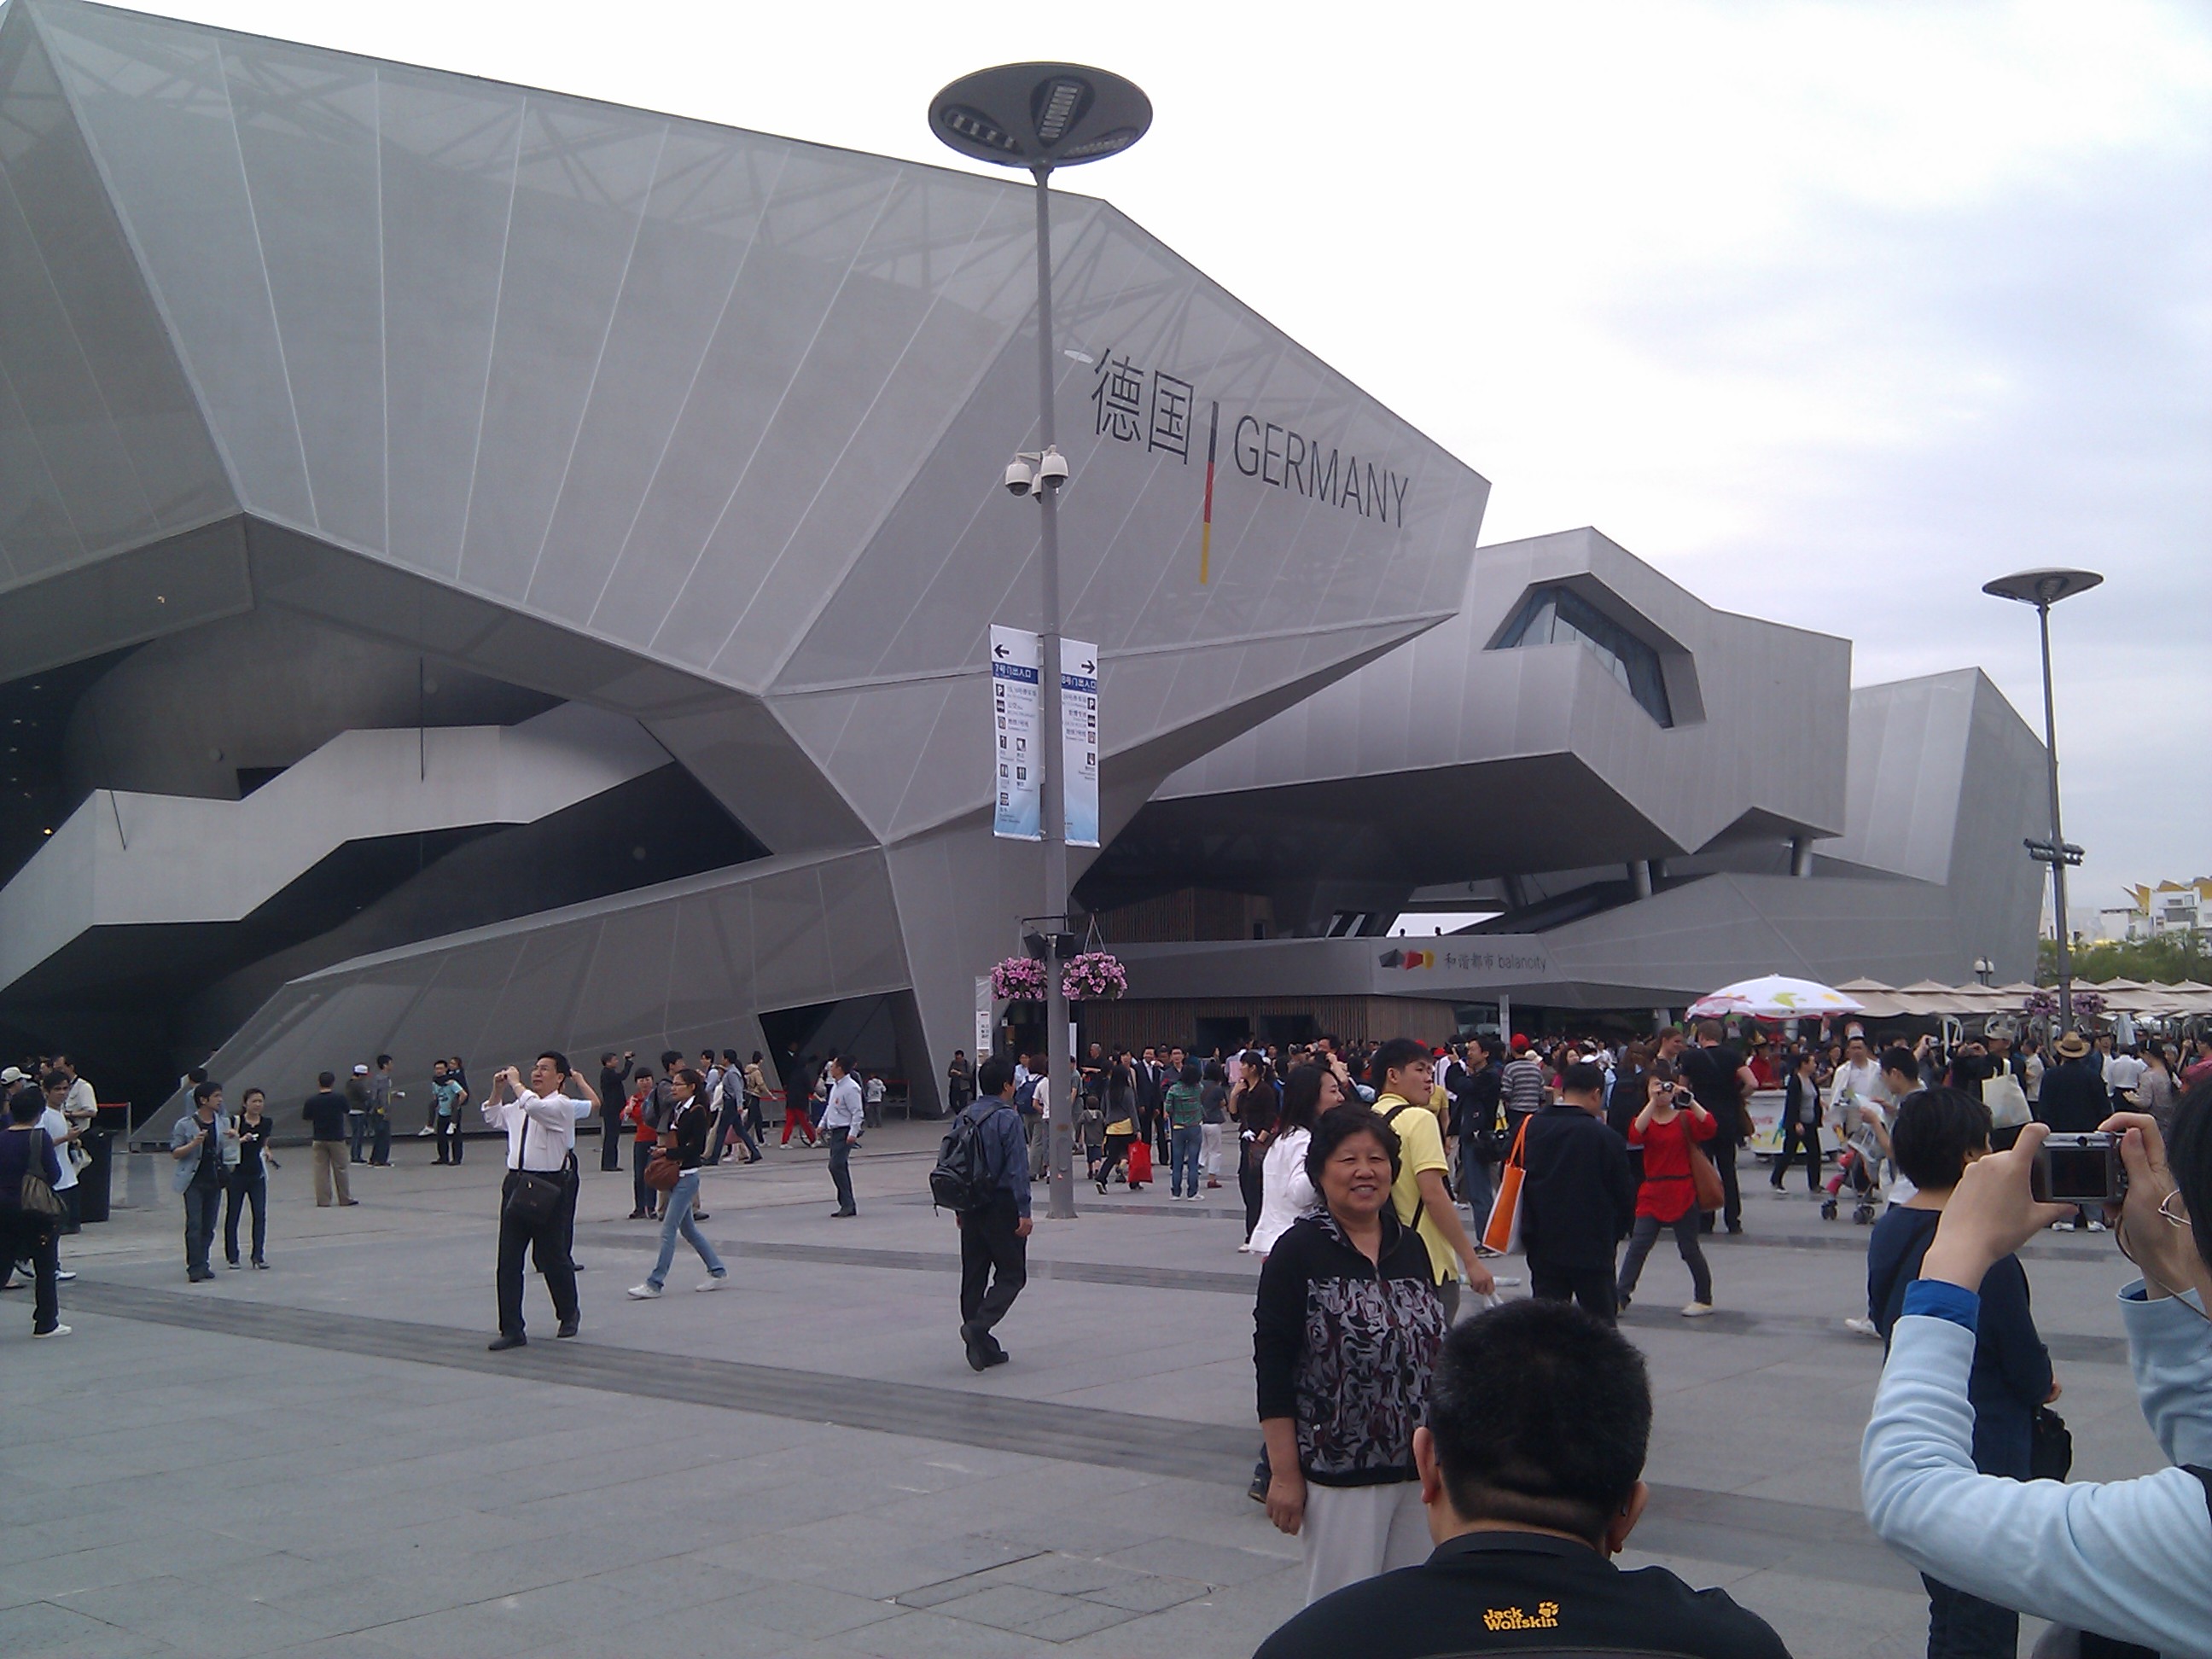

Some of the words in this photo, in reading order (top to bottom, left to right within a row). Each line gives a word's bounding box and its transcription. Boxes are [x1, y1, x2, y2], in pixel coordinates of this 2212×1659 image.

[1091, 347, 1194, 465] 德国
[1234, 415, 1409, 528] GERMANY
[1444, 952, 1493, 969] 和谐都市
[1498, 953, 1546, 973] balancity
[1483, 1607, 1523, 1619] Jack
[1484, 1616, 1558, 1631] Wolfskin
